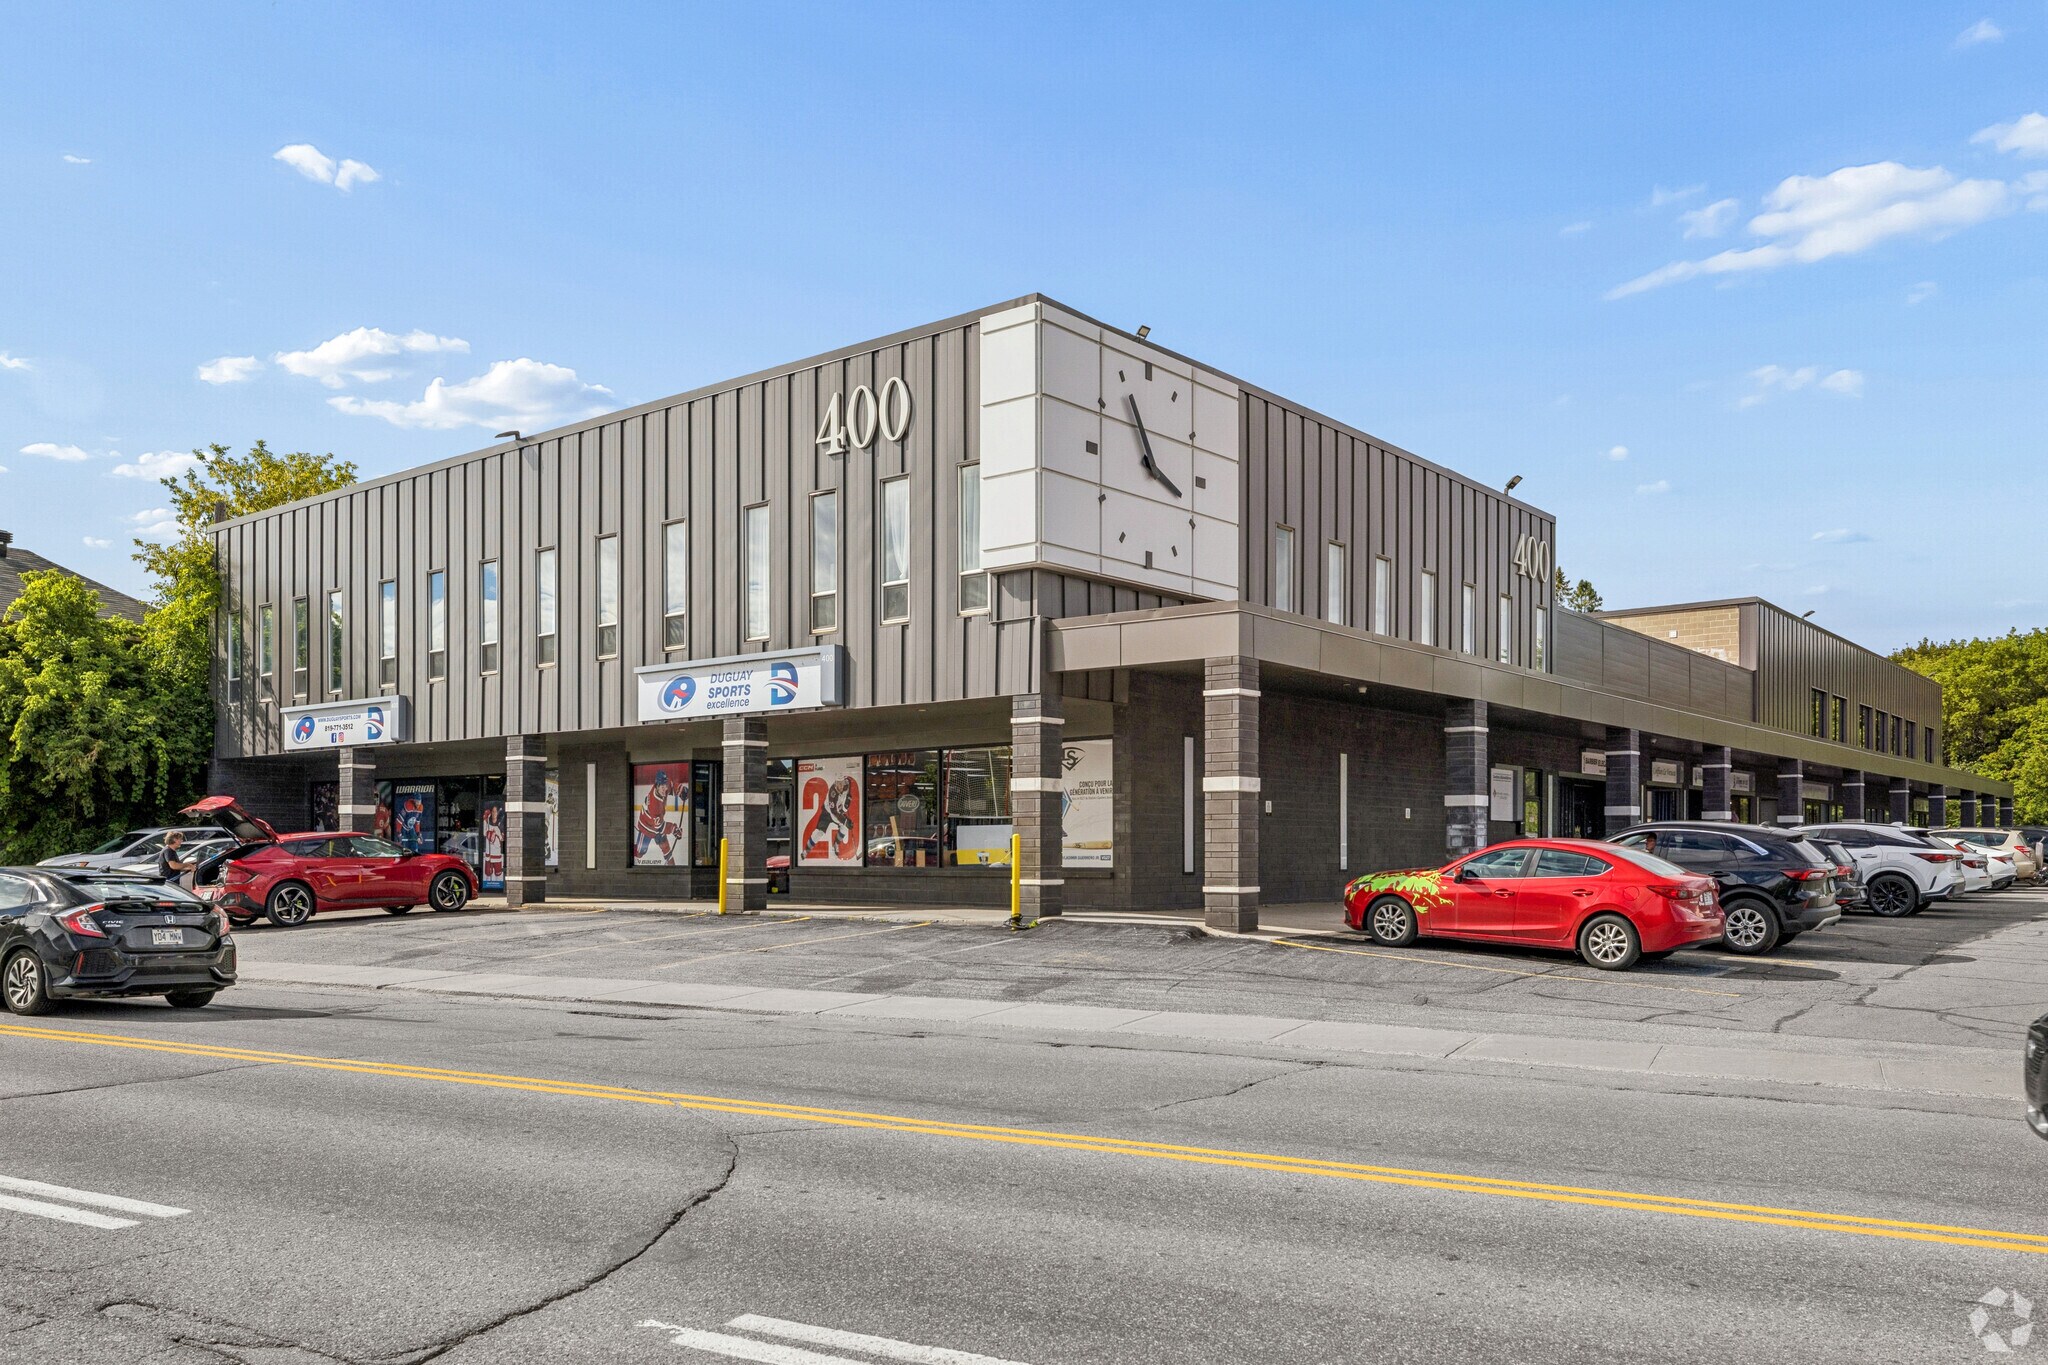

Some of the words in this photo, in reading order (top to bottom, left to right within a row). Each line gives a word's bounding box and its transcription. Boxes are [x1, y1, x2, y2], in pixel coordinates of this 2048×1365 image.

[816, 377, 911, 455] 400
[1513, 533, 1550, 583] 400
[822, 654, 834, 662] 400
[710, 670, 753, 684] DUGUAY
[708, 684, 751, 699] SPORTS
[706, 698, 750, 710] excellence
[324, 723, 354, 732] 819-771-3512
[396, 784, 435, 794] WARRIOR
